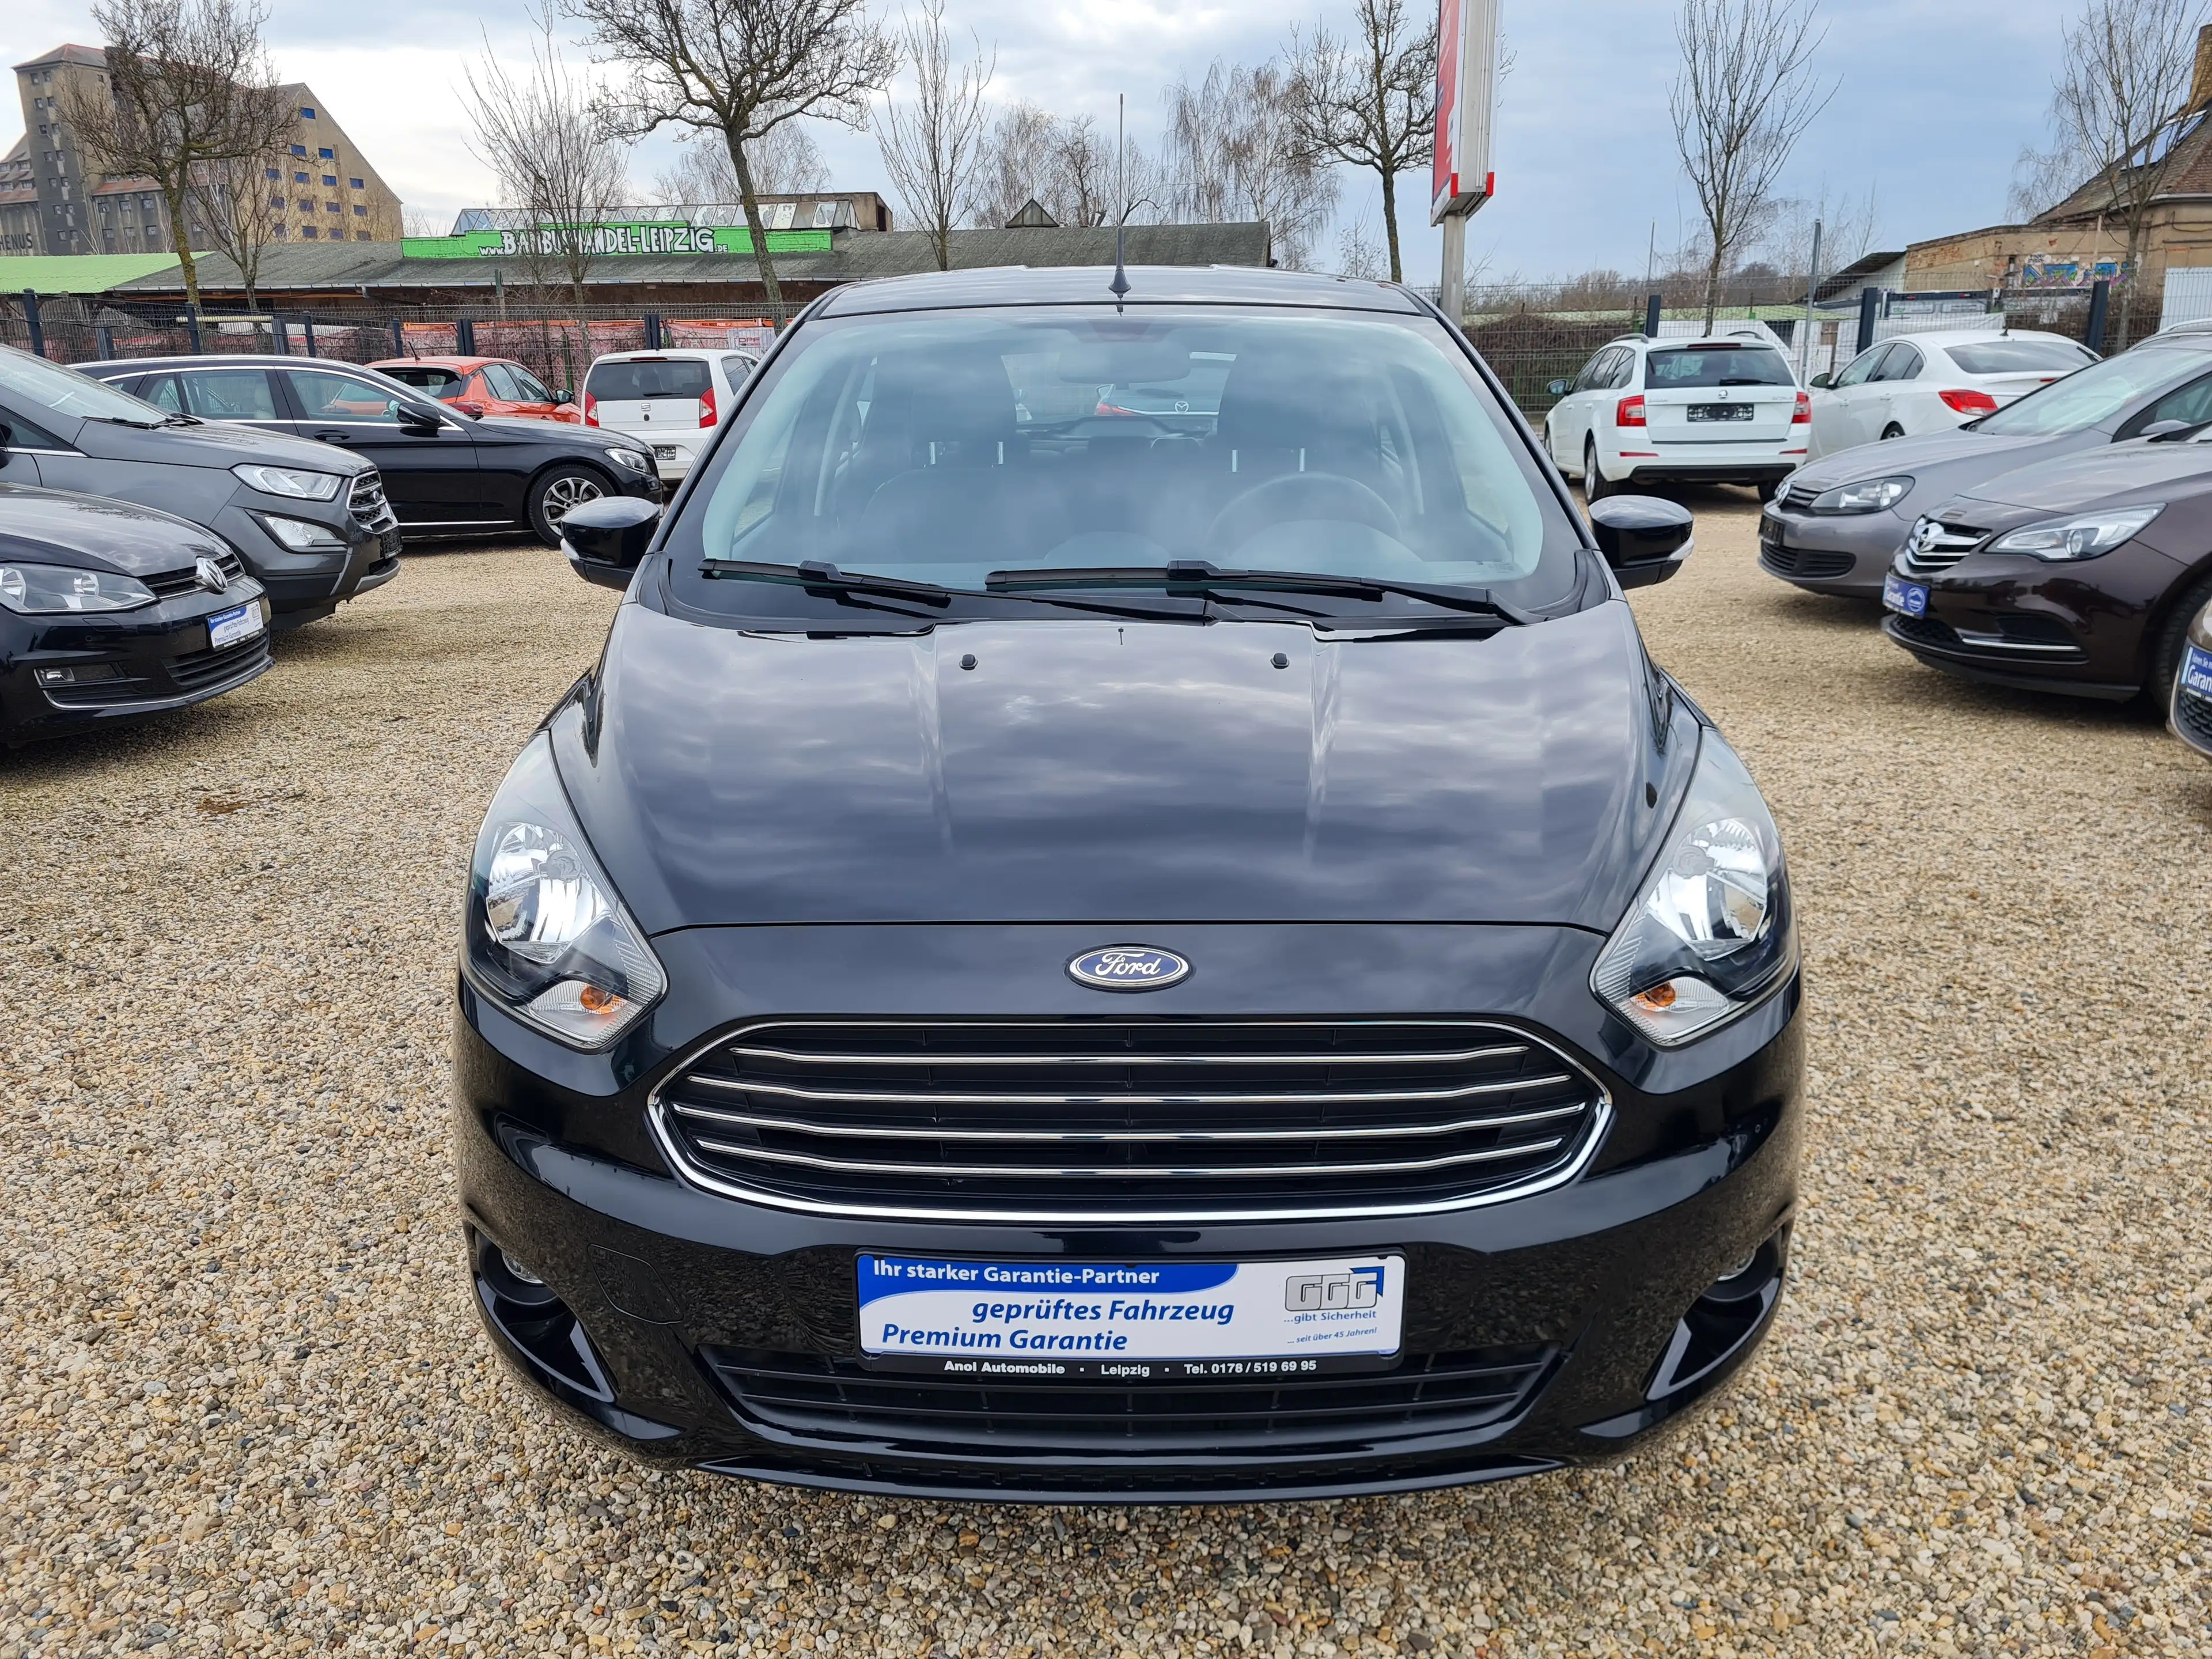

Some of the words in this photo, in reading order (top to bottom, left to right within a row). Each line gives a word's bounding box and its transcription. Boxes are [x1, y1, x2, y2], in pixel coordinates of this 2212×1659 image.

[2188, 664, 2212, 694] Garan
[1095, 952, 1161, 976] Ford
[874, 1260, 902, 1277] Ihr
[907, 1264, 979, 1281] starker
[984, 1267, 1160, 1284] Garantie-Partner
[972, 1299, 1101, 1324] geprüftes
[1108, 1299, 1234, 1325] Fahrzeug
[1321, 1310, 1377, 1321] Sicherheit
[882, 1323, 1002, 1349] Premium
[1009, 1329, 1128, 1351] Garantie
[1296, 1335, 1310, 1343] seit
[1313, 1333, 1332, 1341] über
[1346, 1327, 1377, 1337] Jahren!
[944, 1361, 977, 1372] Anol
[981, 1362, 1065, 1374] Automobile
[1101, 1364, 1150, 1377] Leipzig
[1184, 1363, 1207, 1374] Tel.
[1281, 1361, 1297, 1372] 69
[1301, 1360, 1317, 1371] 95
